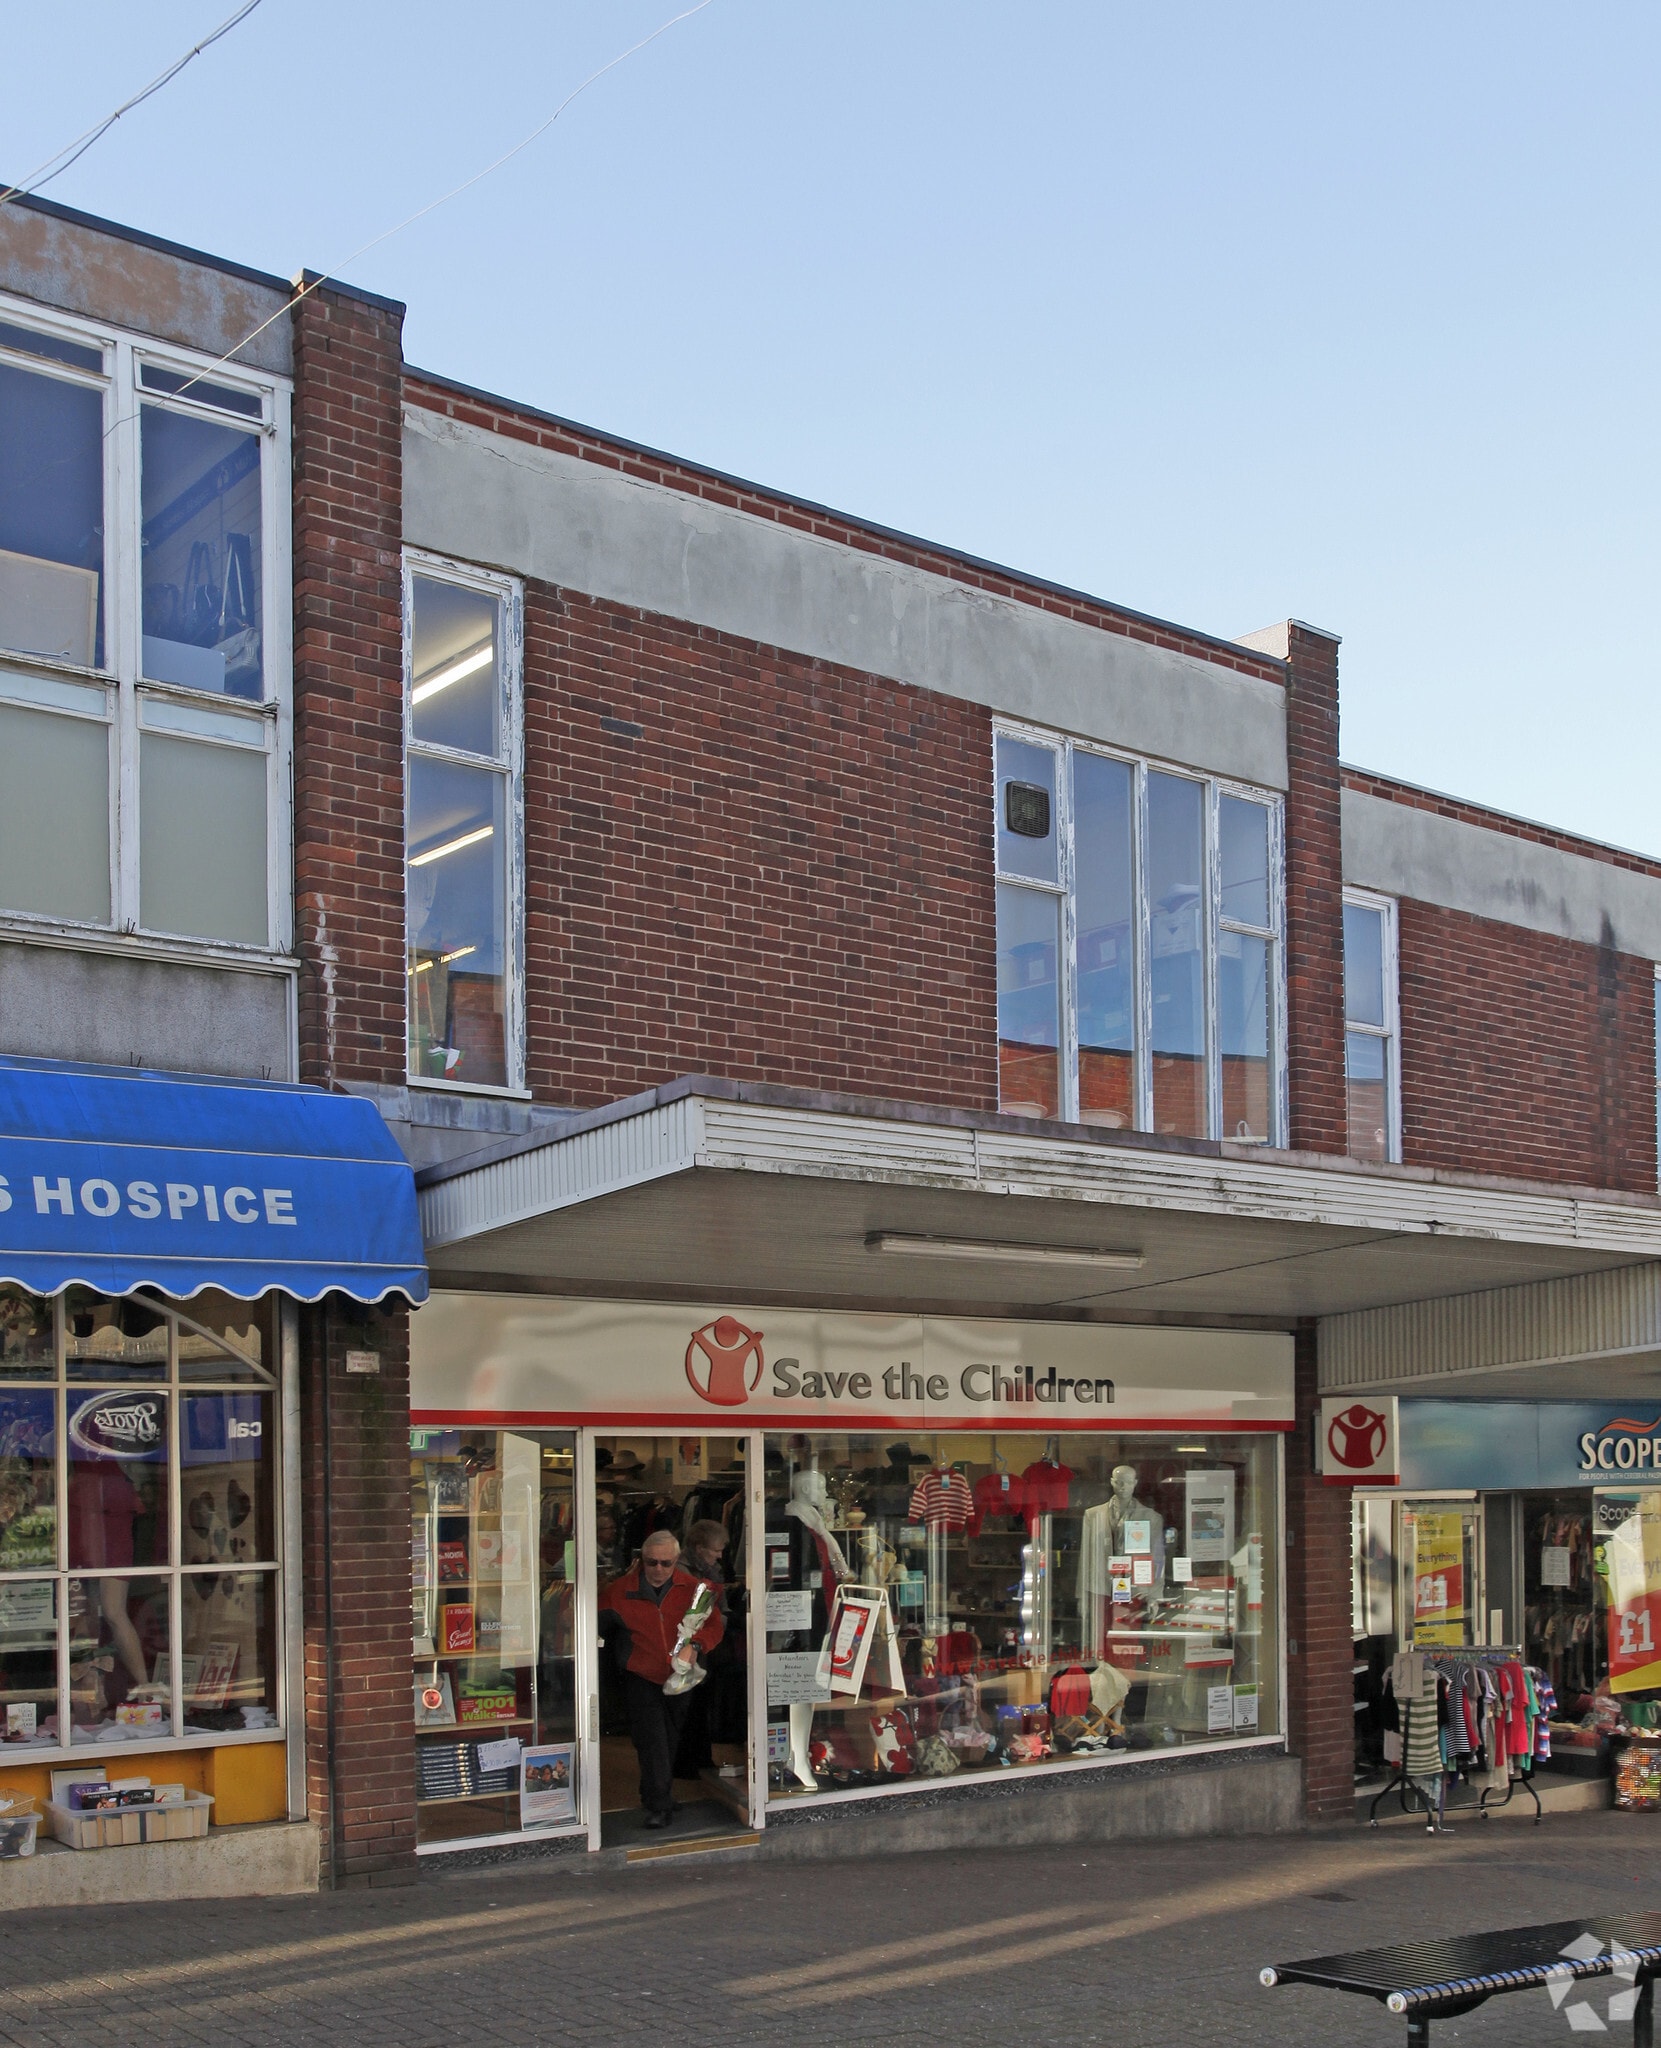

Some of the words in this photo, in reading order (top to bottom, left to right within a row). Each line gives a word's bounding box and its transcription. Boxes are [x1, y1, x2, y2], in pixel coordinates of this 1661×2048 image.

[33, 1176, 297, 1225] HOSPICE
[772, 1358, 873, 1399] Save
[882, 1362, 949, 1401] the
[960, 1363, 1115, 1404] Children
[1581, 1433, 1661, 1470] SCOPE
[1418, 1552, 1458, 1565] Everything
[1418, 1575, 1448, 1608] £1
[1620, 1610, 1655, 1654] £1
[461, 1709, 496, 1721] Walks
[475, 1696, 515, 1710] 1001
